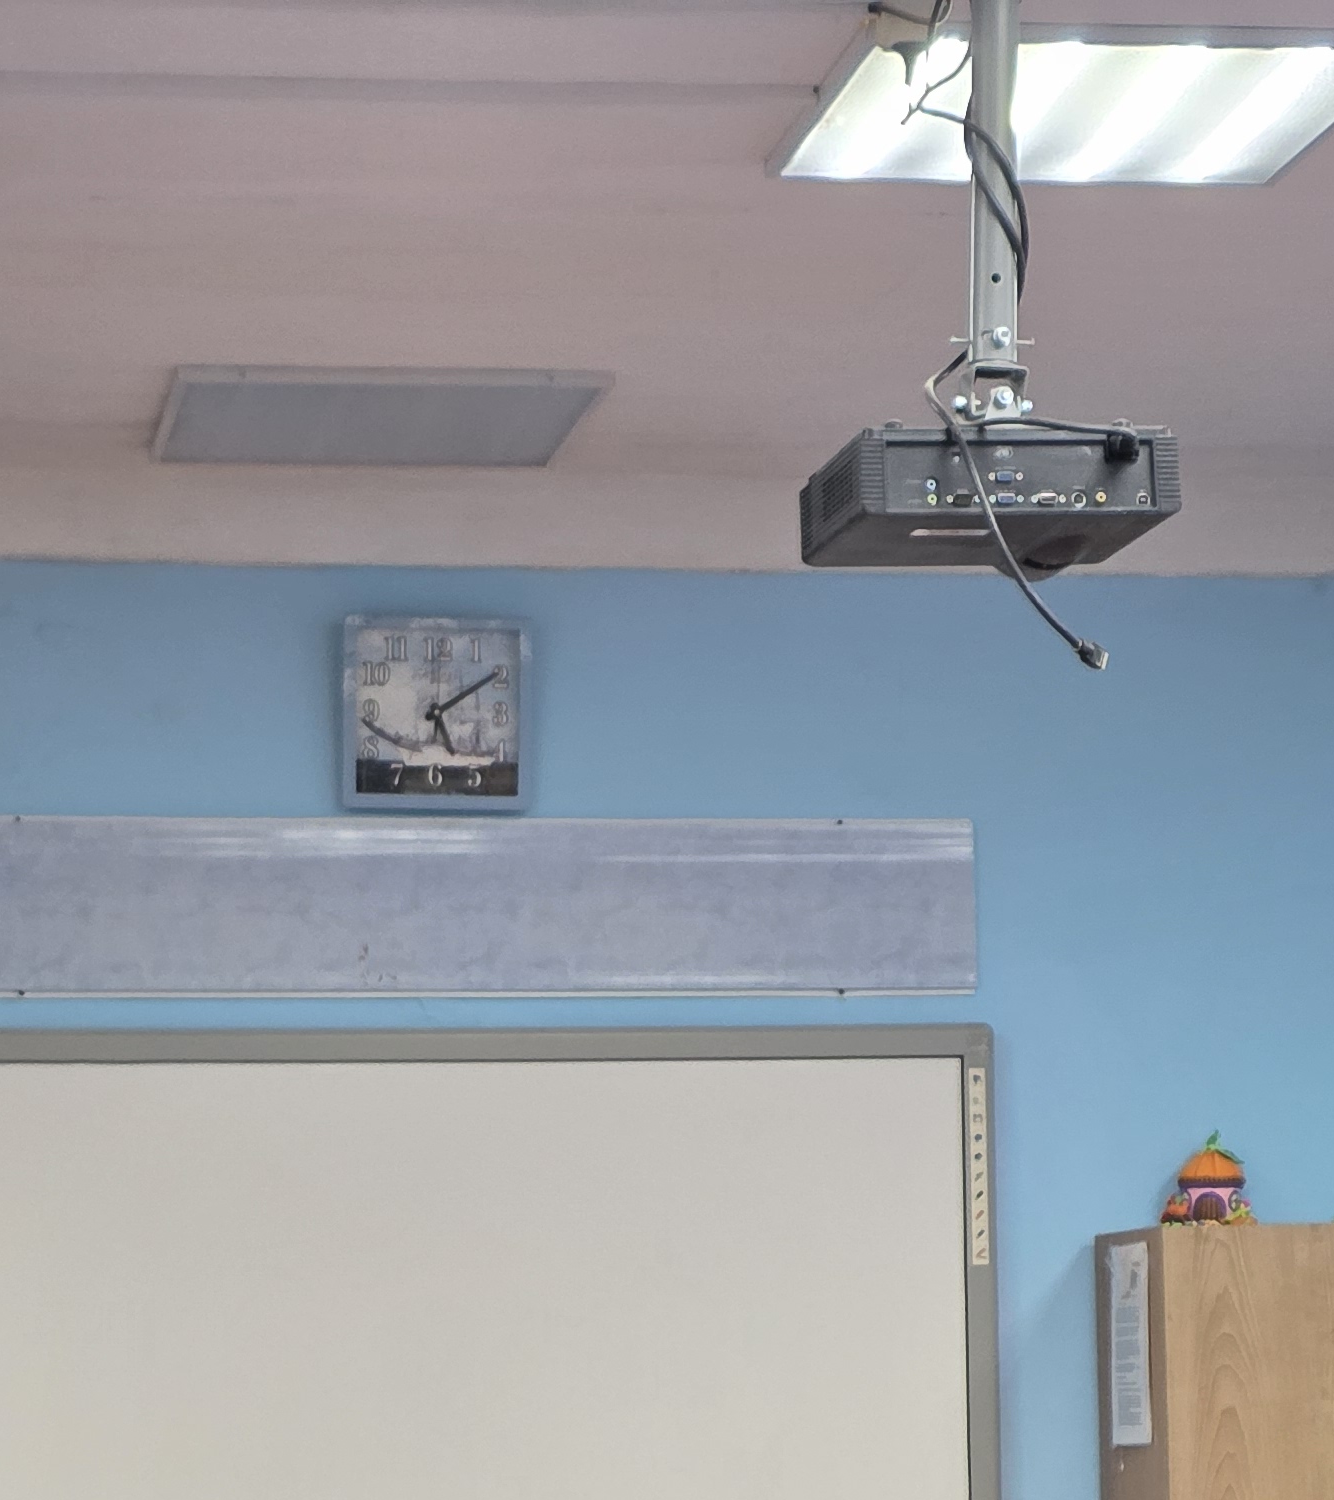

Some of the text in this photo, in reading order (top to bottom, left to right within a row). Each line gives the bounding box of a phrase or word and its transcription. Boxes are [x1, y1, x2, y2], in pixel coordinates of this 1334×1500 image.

[384, 636, 482, 663] 11 12 1
[363, 661, 509, 688] 10 2
[363, 698, 509, 726] 9 3
[363, 736, 379, 759] 8
[390, 763, 482, 788] 7 6 5
